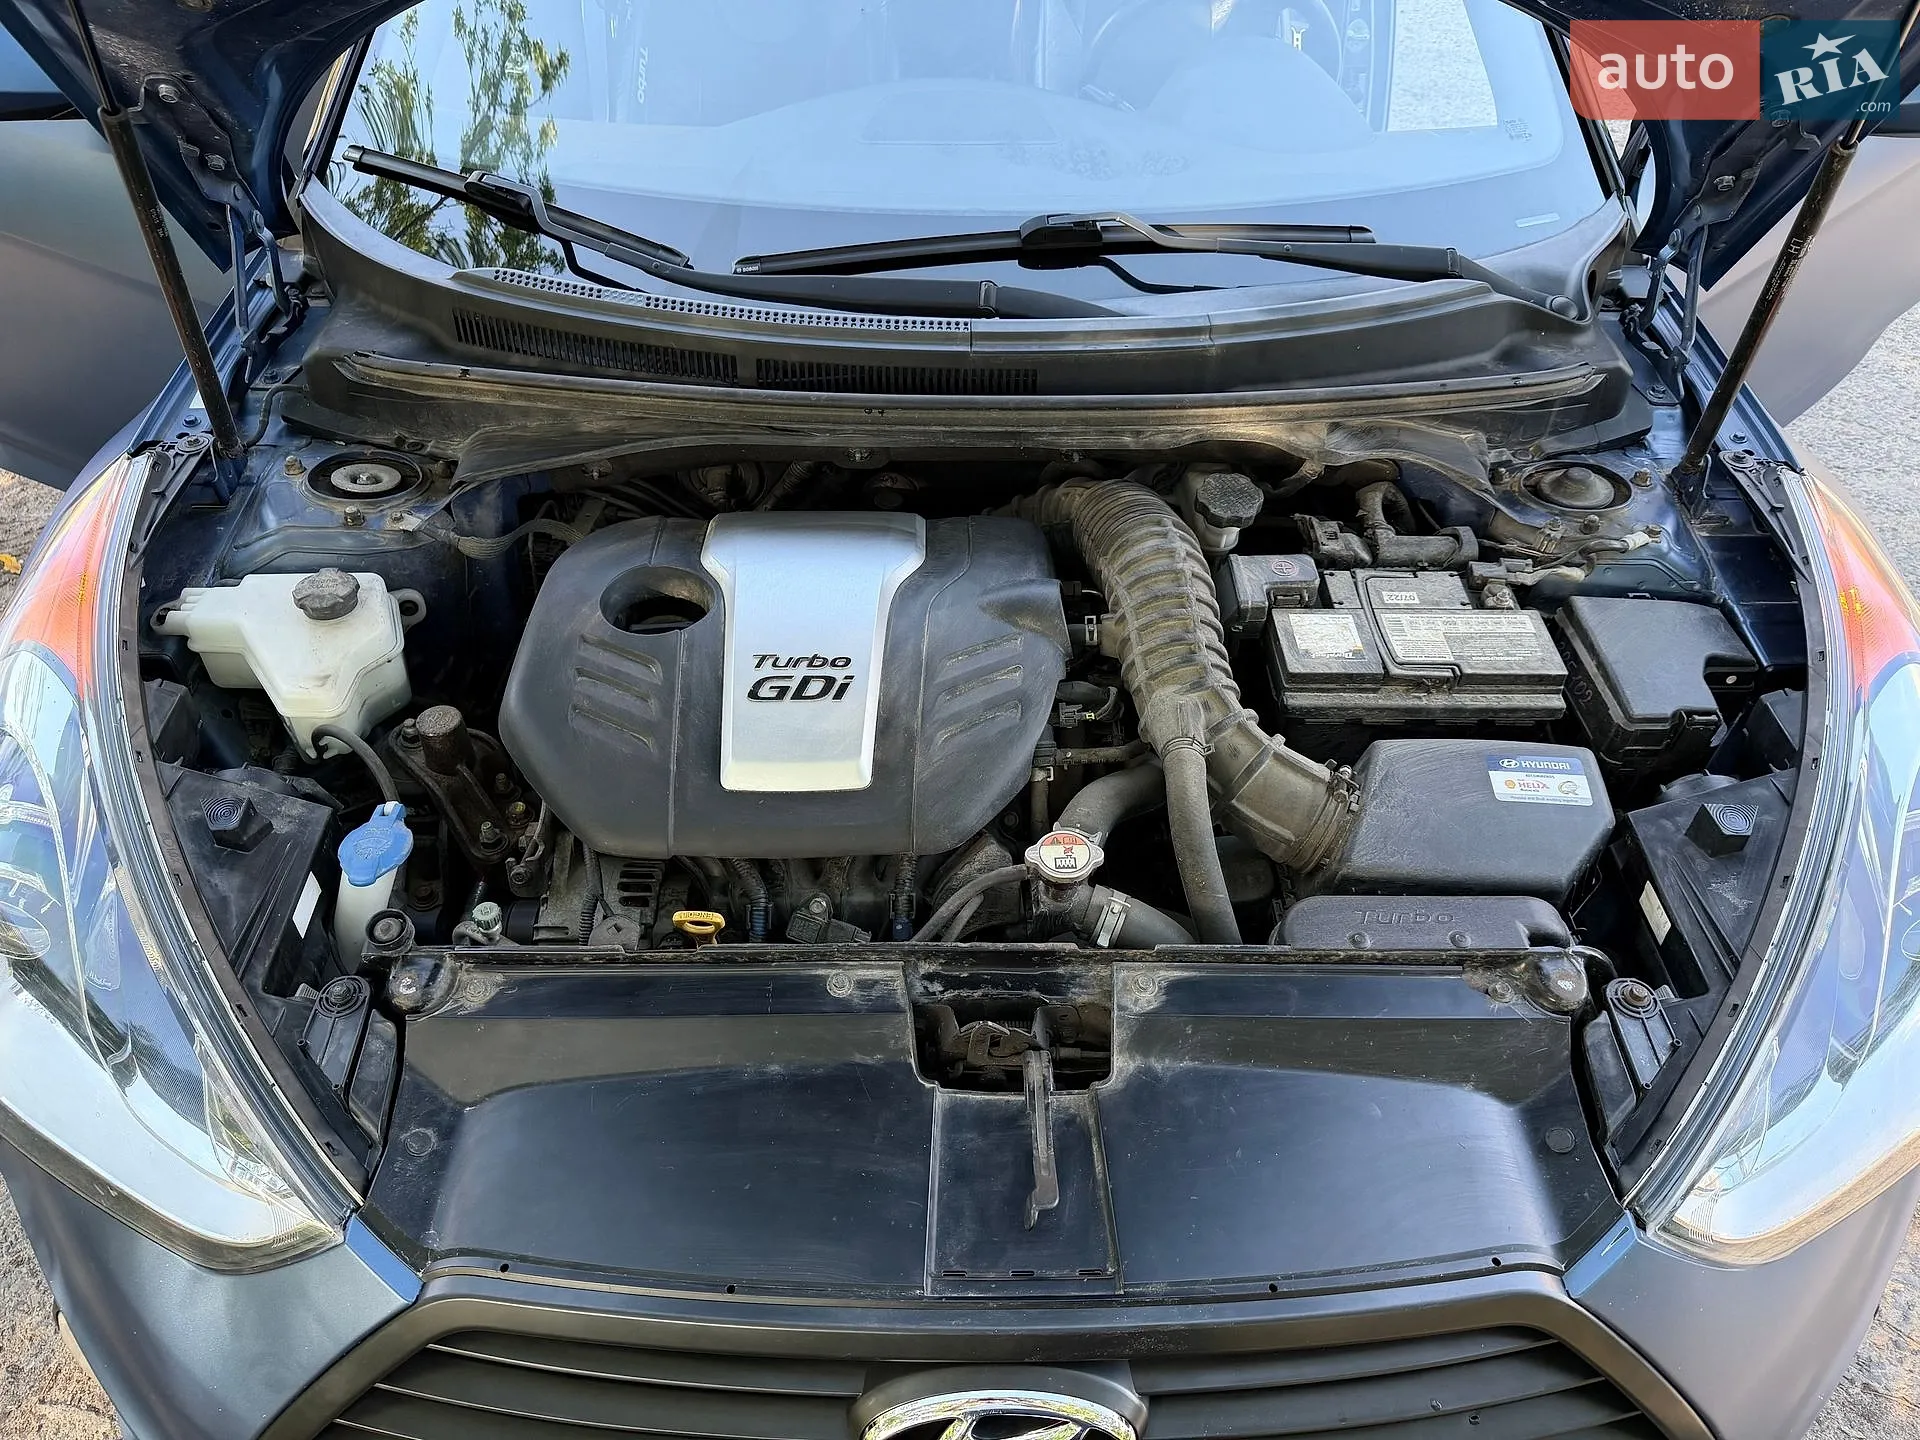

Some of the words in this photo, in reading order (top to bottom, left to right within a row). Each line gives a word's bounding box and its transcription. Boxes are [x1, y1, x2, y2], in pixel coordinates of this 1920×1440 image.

[637, 46, 648, 104] Turbo
[752, 653, 852, 670] Turbo
[746, 674, 856, 702] GDi
[1520, 760, 1571, 770] HYUNDAI
[1353, 908, 1456, 925] Turbo
